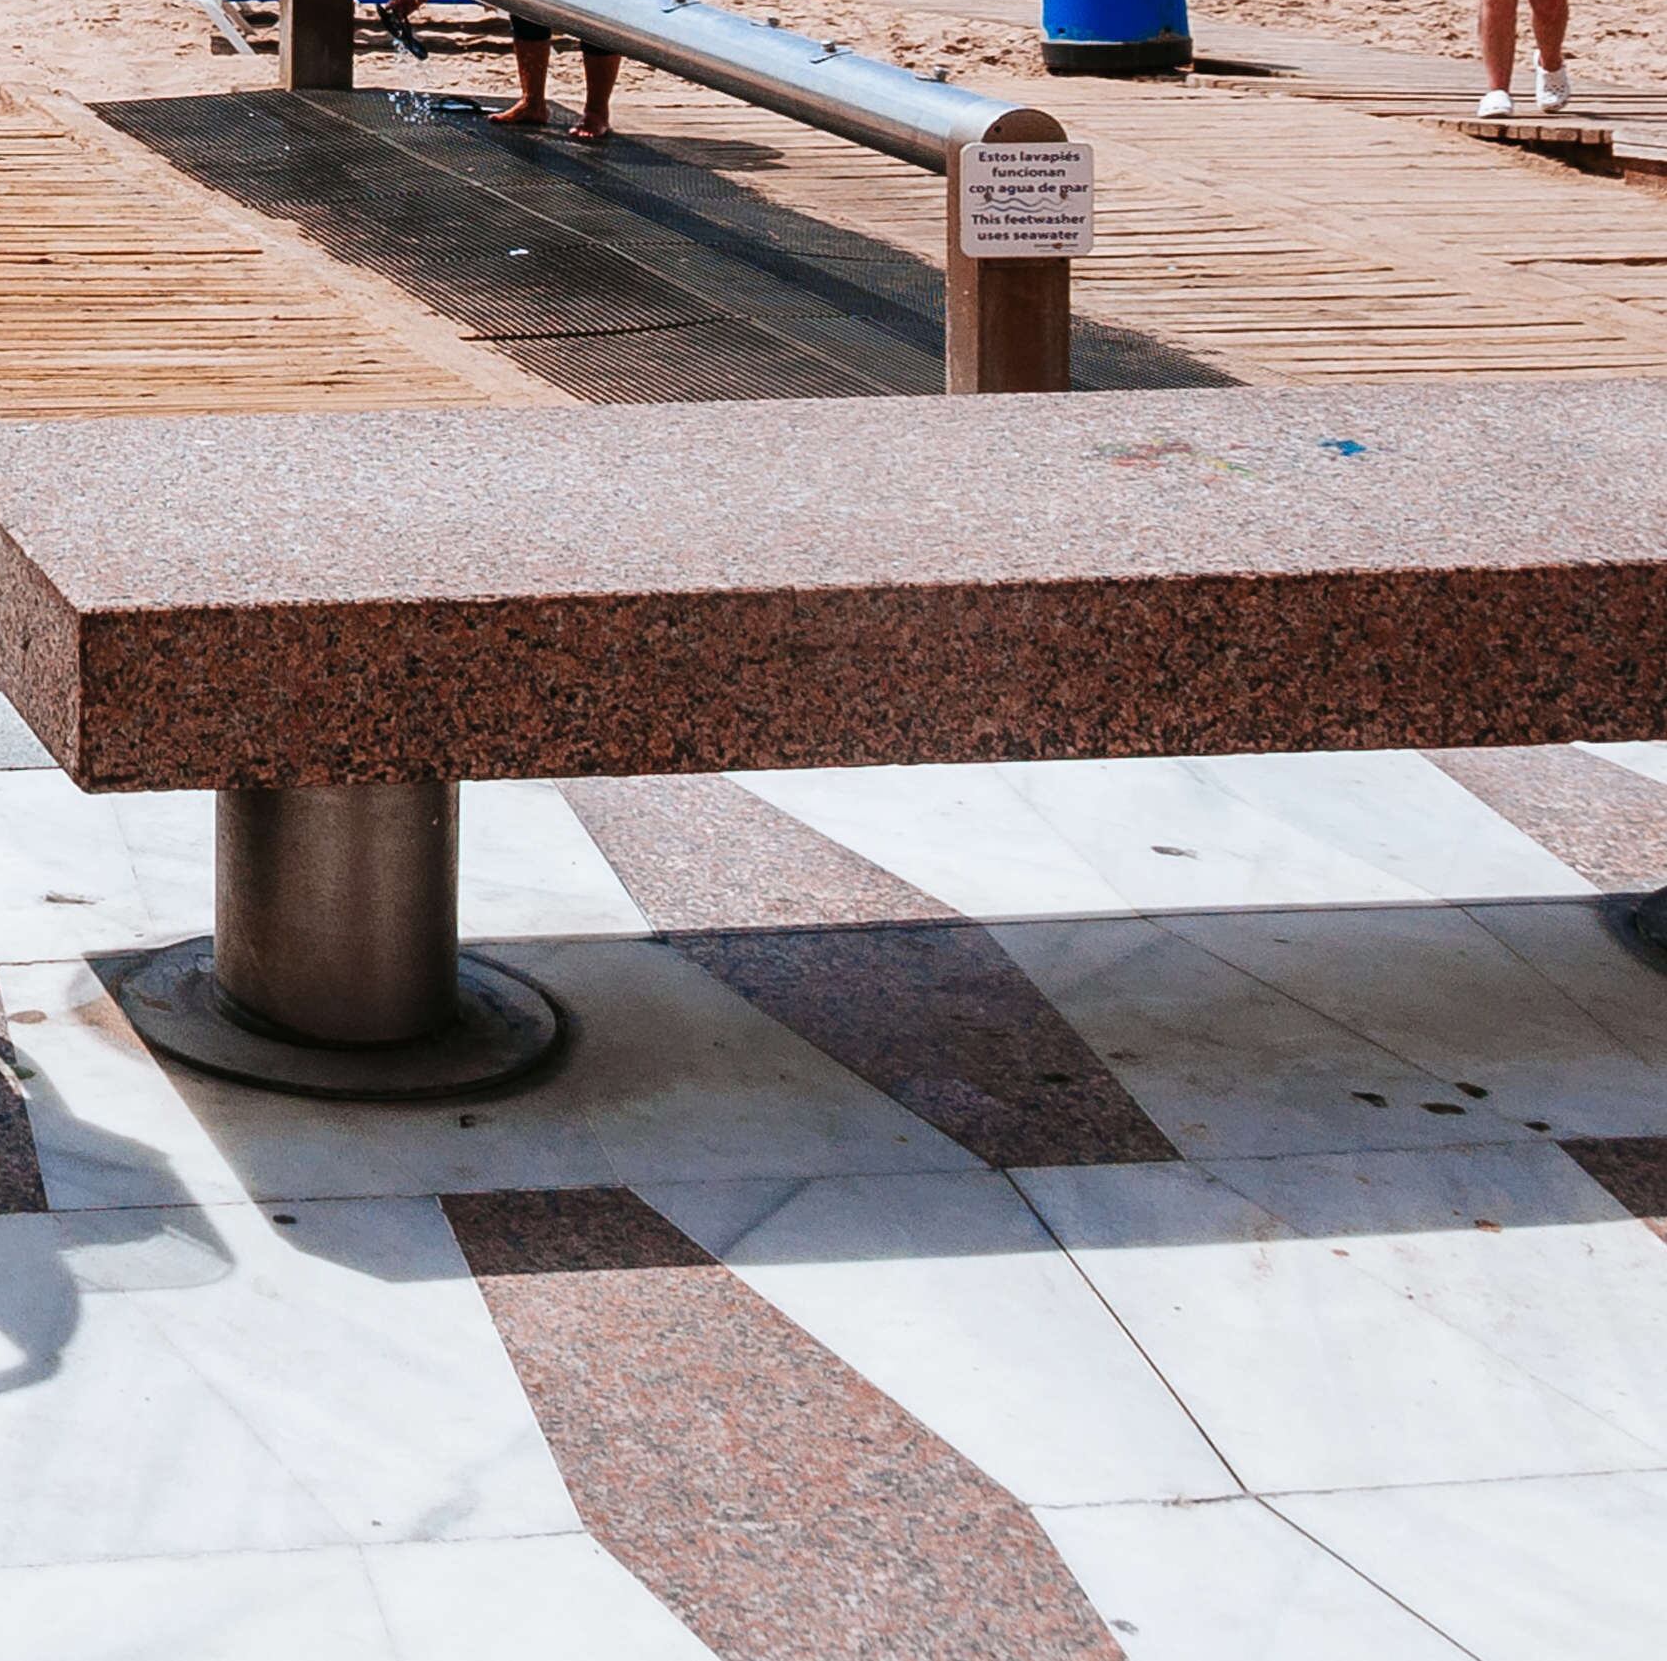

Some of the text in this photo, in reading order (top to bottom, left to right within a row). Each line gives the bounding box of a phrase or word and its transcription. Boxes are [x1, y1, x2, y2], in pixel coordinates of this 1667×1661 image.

[978, 151, 1080, 164] Estos lavapiés
[992, 167, 1066, 178] funcionan
[969, 182, 1088, 196] con agua de mar
[971, 213, 1086, 225] This feetwasher
[977, 230, 1079, 241] uses seawater
